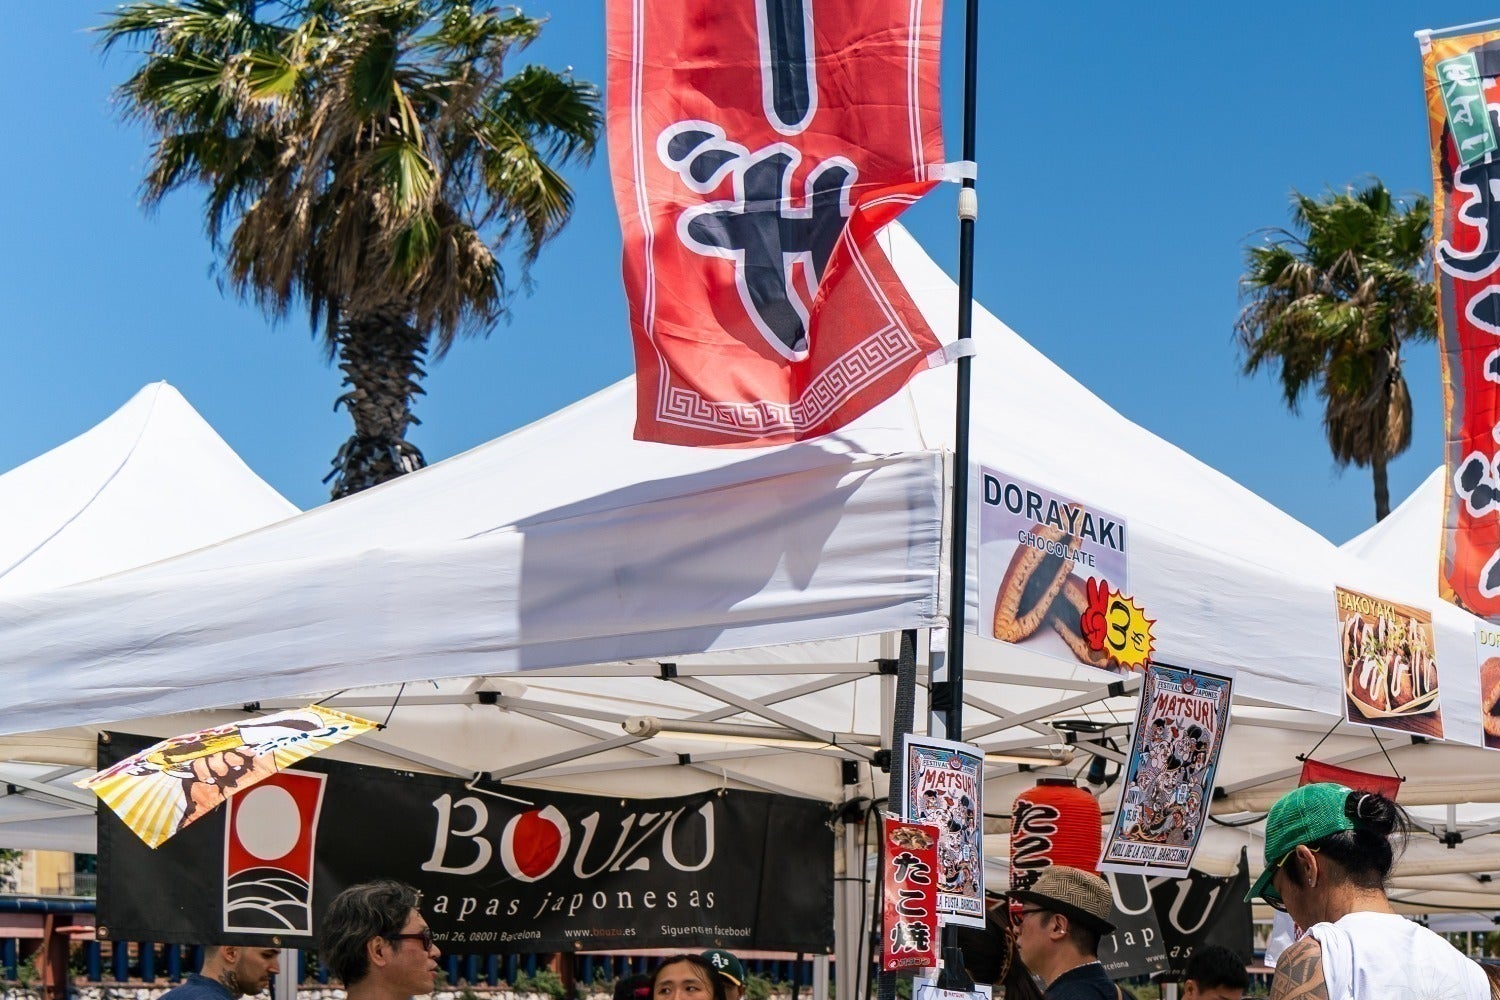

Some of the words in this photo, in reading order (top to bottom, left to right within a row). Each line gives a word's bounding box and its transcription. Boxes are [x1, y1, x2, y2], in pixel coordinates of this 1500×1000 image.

[984, 473, 1125, 553] DORAYAKI
[1018, 529, 1096, 568] CHOCOLATE
[1337, 590, 1396, 621] TAKOYAKI
[1153, 692, 1213, 732] MATSURI
[922, 769, 976, 802] MATSURI
[421, 793, 714, 883] BOUZU
[414, 889, 520, 922] tapas
[533, 889, 715, 920] japonesas
[890, 851, 931, 955] たこ焼
[452, 932, 467, 943] 26,
[469, 931, 498, 942] 08001
[500, 929, 541, 942] Barcelona
[564, 927, 636, 938] www.bouzu.es
[704, 927, 713, 936] en
